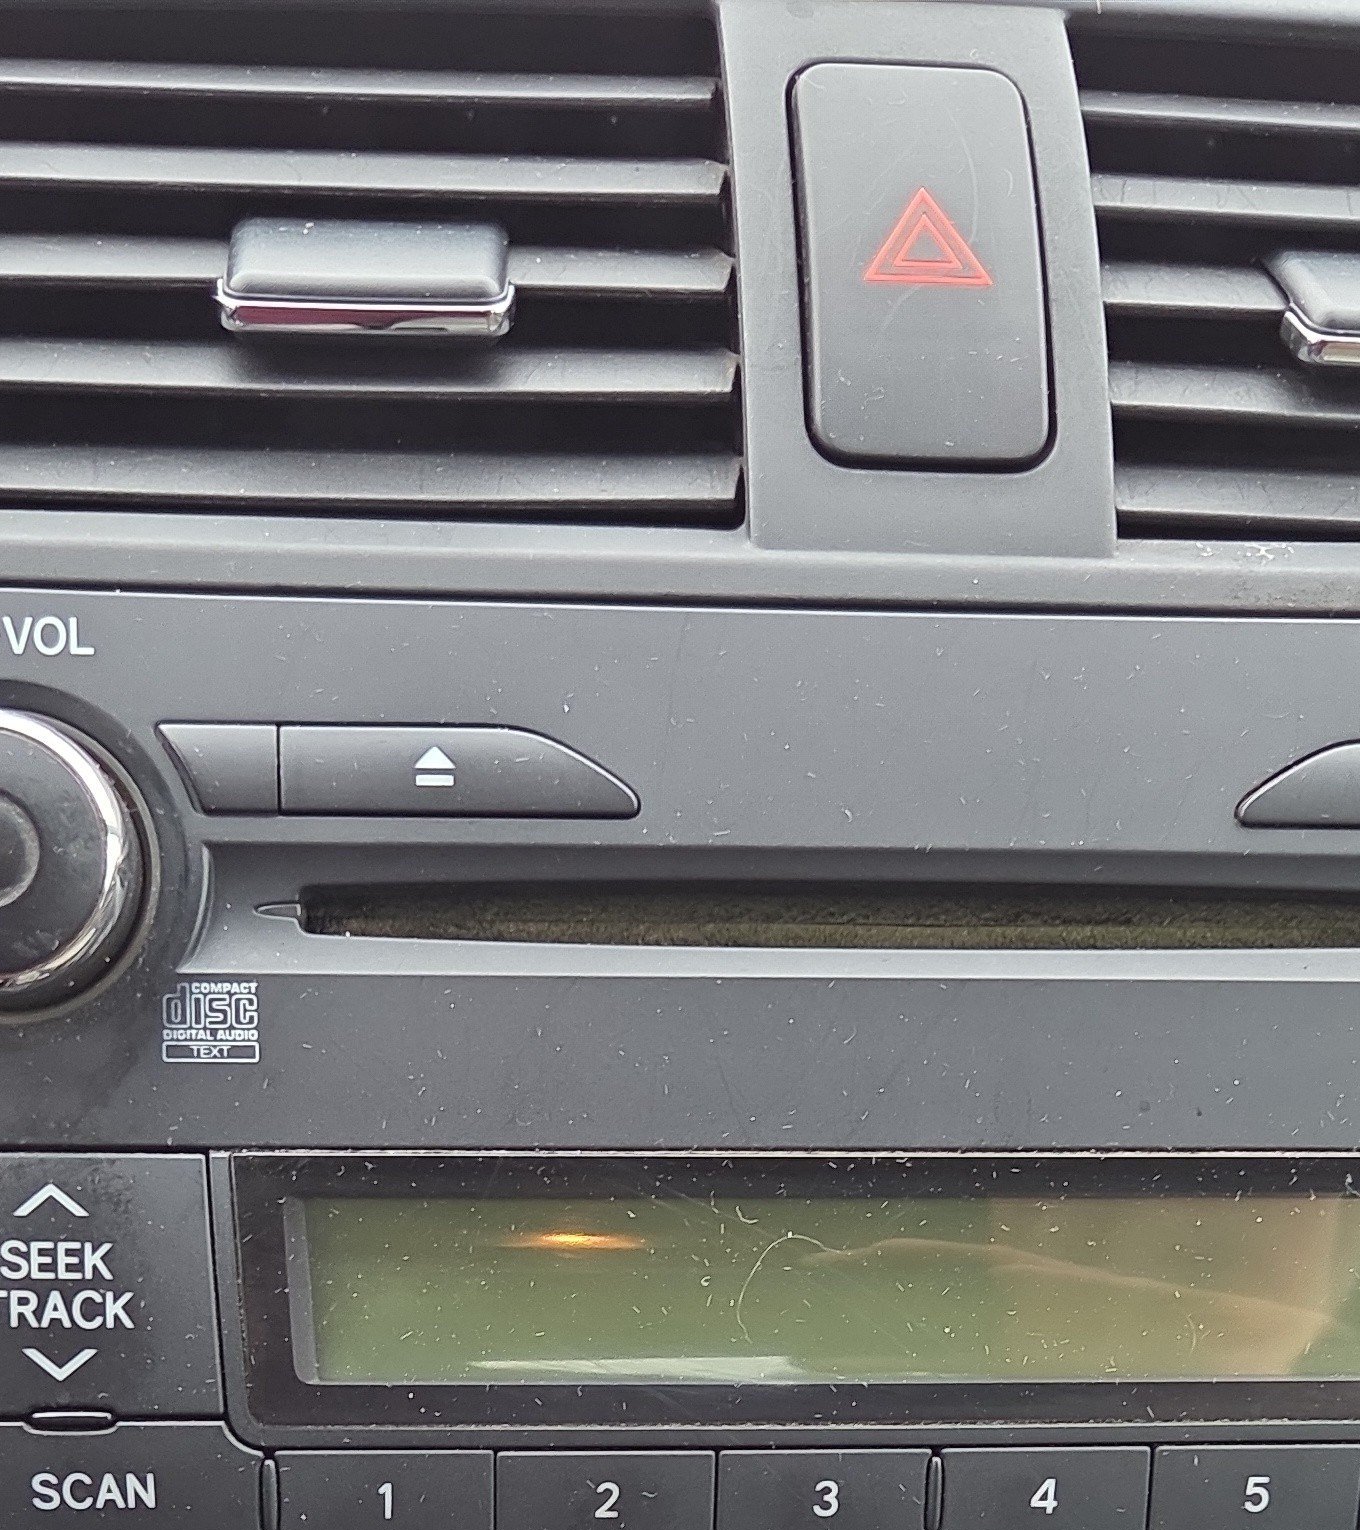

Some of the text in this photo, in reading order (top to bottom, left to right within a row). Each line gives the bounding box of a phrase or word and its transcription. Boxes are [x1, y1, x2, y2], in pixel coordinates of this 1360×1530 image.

[190, 982, 259, 994] COMPACT
[162, 1028, 259, 1041] DIGITAL AUDIO
[189, 1045, 232, 1058] TEXT
[0, 1239, 114, 1281] SEEK
[30, 1472, 157, 1511] SCAN
[376, 1482, 394, 1520] 1
[593, 1481, 621, 1519] 2
[812, 1479, 840, 1517] 3
[1030, 1477, 1059, 1515] 4
[1243, 1475, 1271, 1513] 5
